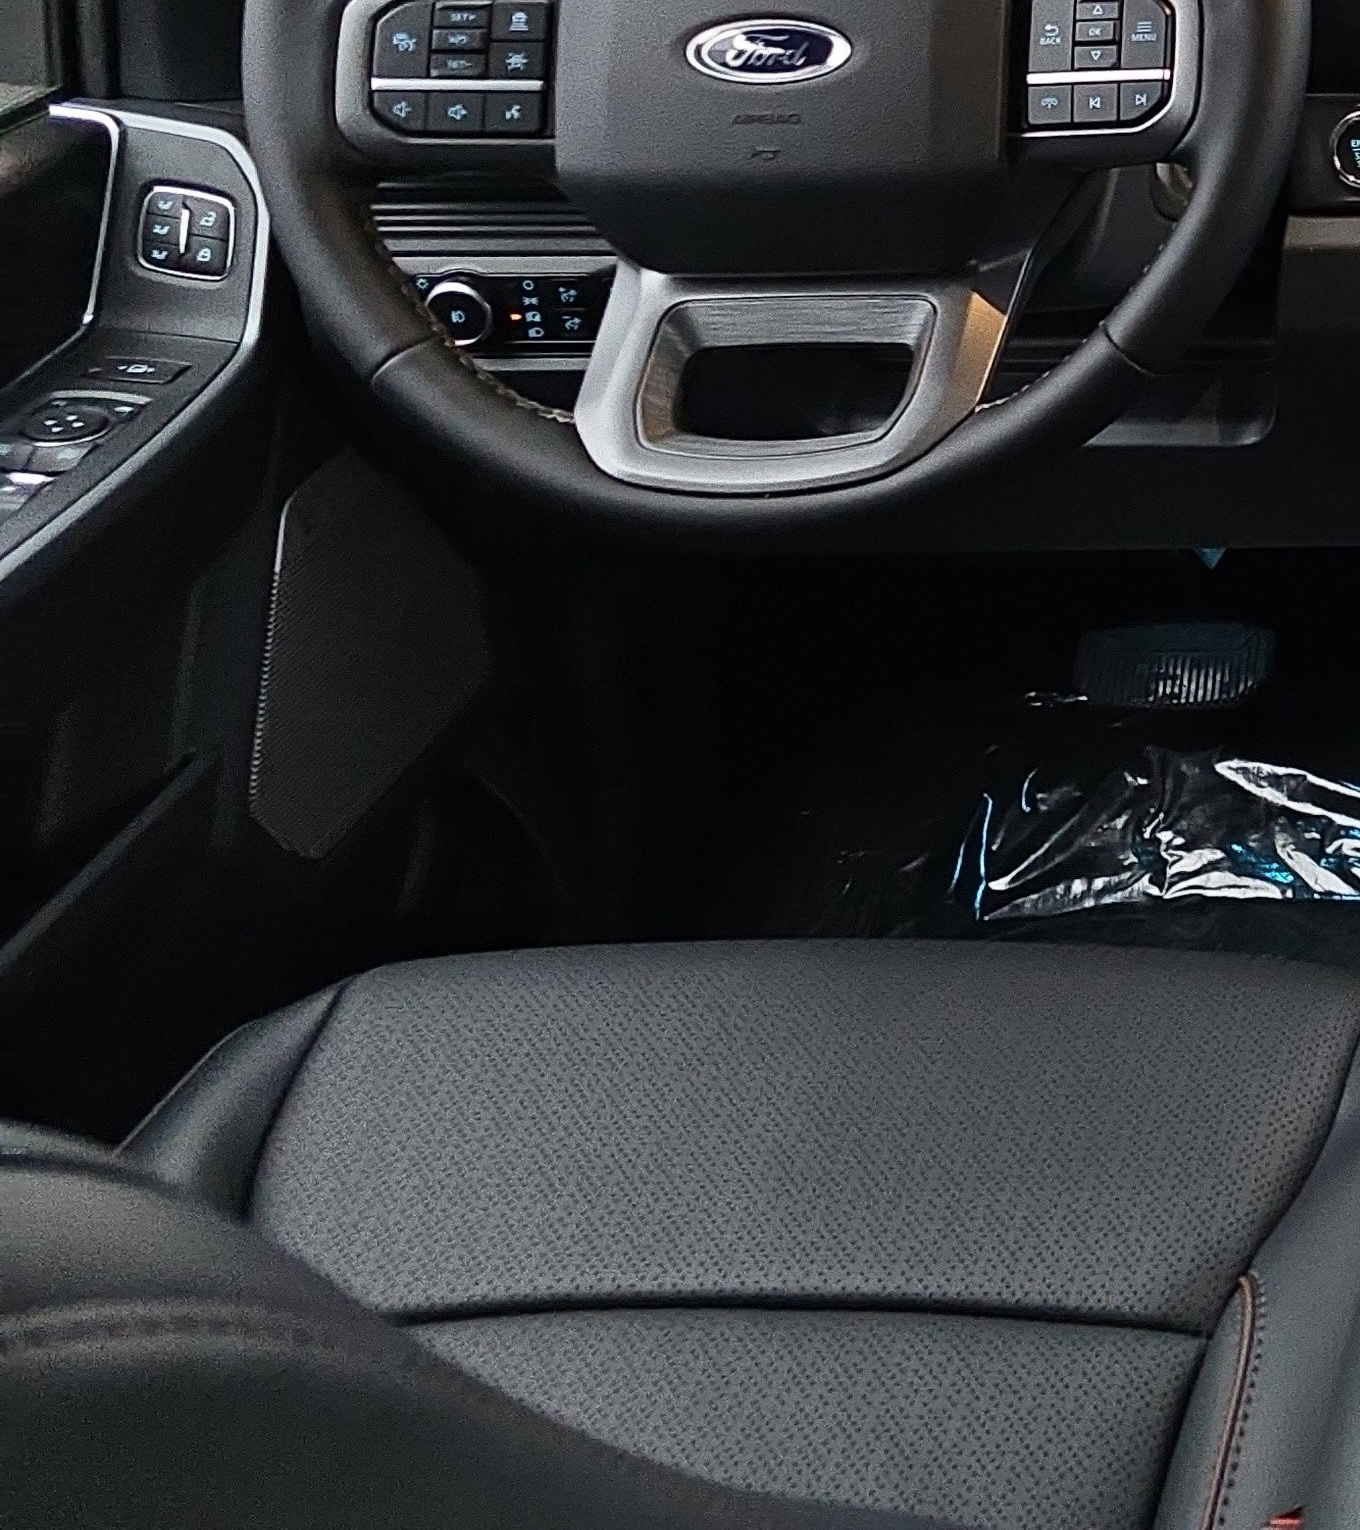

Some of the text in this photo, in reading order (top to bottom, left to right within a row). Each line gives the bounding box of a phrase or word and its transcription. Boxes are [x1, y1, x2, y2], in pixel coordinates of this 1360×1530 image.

[1040, 37, 1061, 45] BACK
[1131, 34, 1157, 42] MENU
[726, 33, 806, 67] Ford
